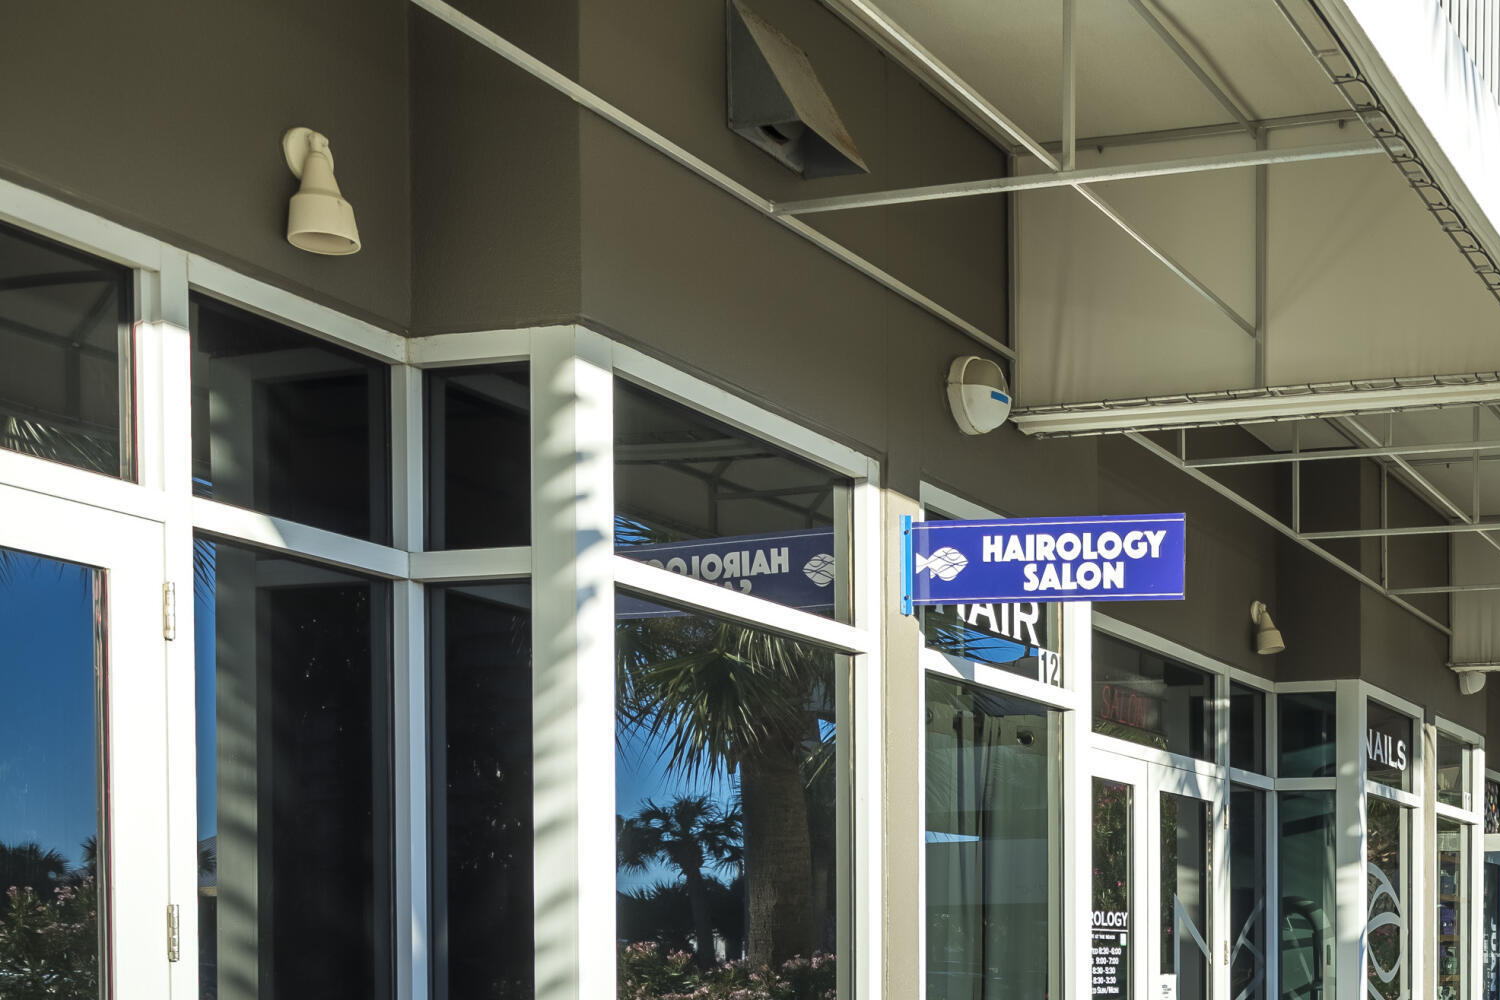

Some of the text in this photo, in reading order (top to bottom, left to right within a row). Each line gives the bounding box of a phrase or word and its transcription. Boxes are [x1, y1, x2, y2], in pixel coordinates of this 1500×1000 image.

[982, 530, 1167, 562] HAIROLOGY
[1023, 561, 1125, 591] SALON
[936, 602, 1040, 647] AIR
[1041, 651, 1058, 687] 12
[1101, 684, 1146, 729] SALON
